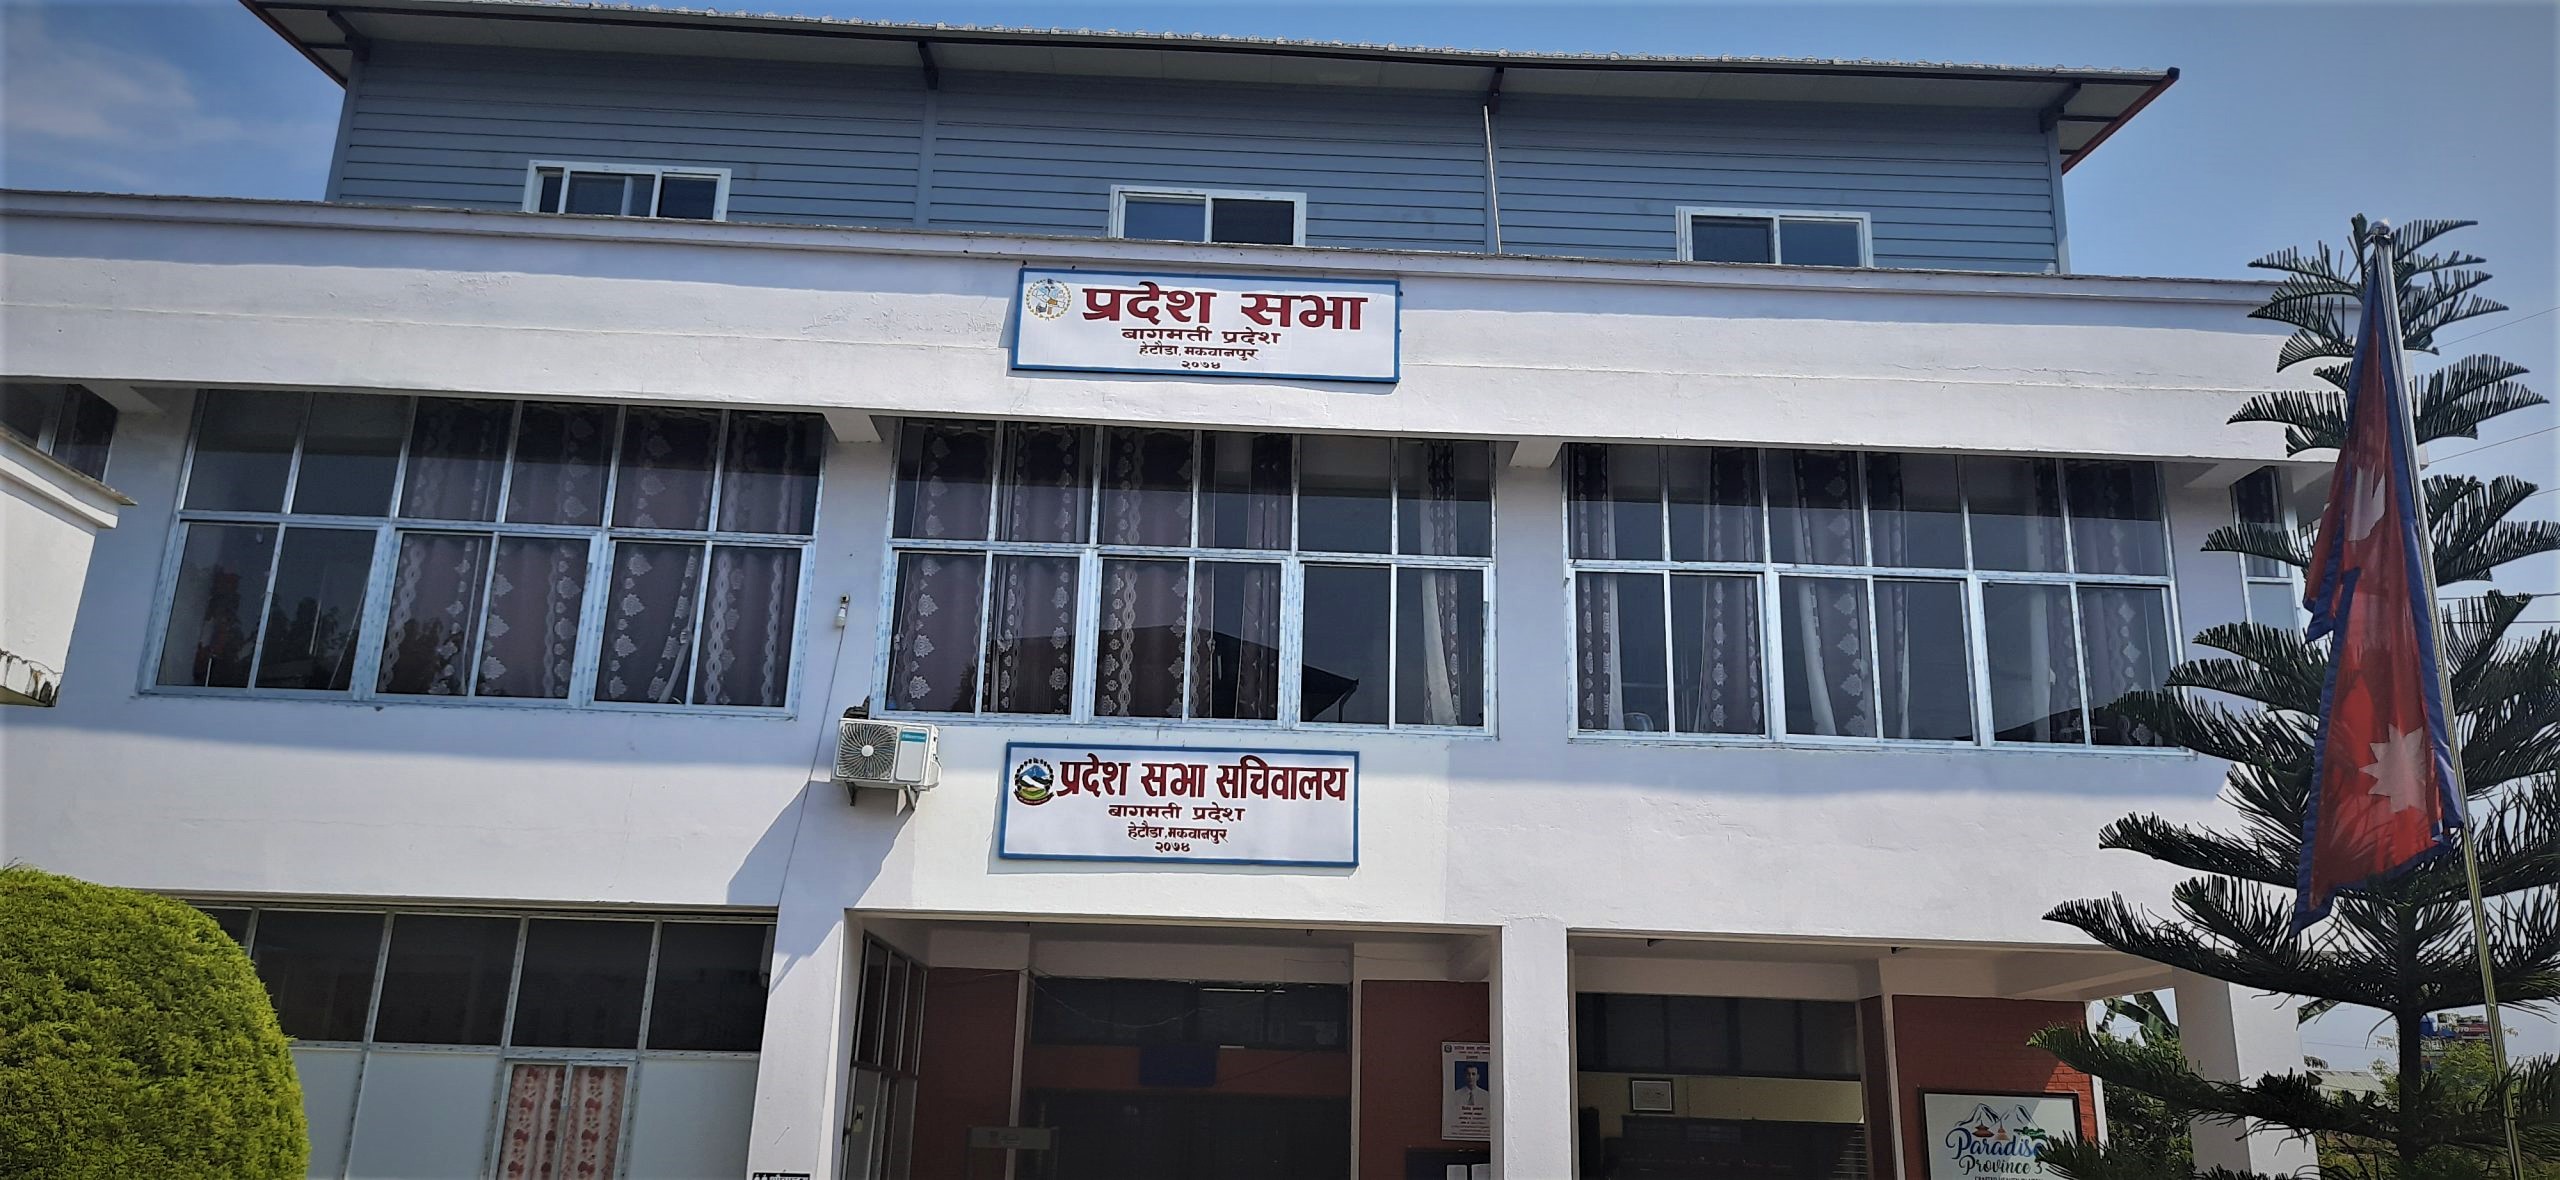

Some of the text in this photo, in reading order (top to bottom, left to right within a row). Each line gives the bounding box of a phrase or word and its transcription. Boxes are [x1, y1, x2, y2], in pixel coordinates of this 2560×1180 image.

[1081, 281, 1369, 330] प्रदेश सभा
[1121, 326, 1282, 345] बागमती प्रदेश
[1056, 753, 1350, 801] प्रदेश सभा सचिवालय
[1108, 802, 1246, 824] बागमती प्रदेश
[1959, 1154, 2043, 1175] Province 3
